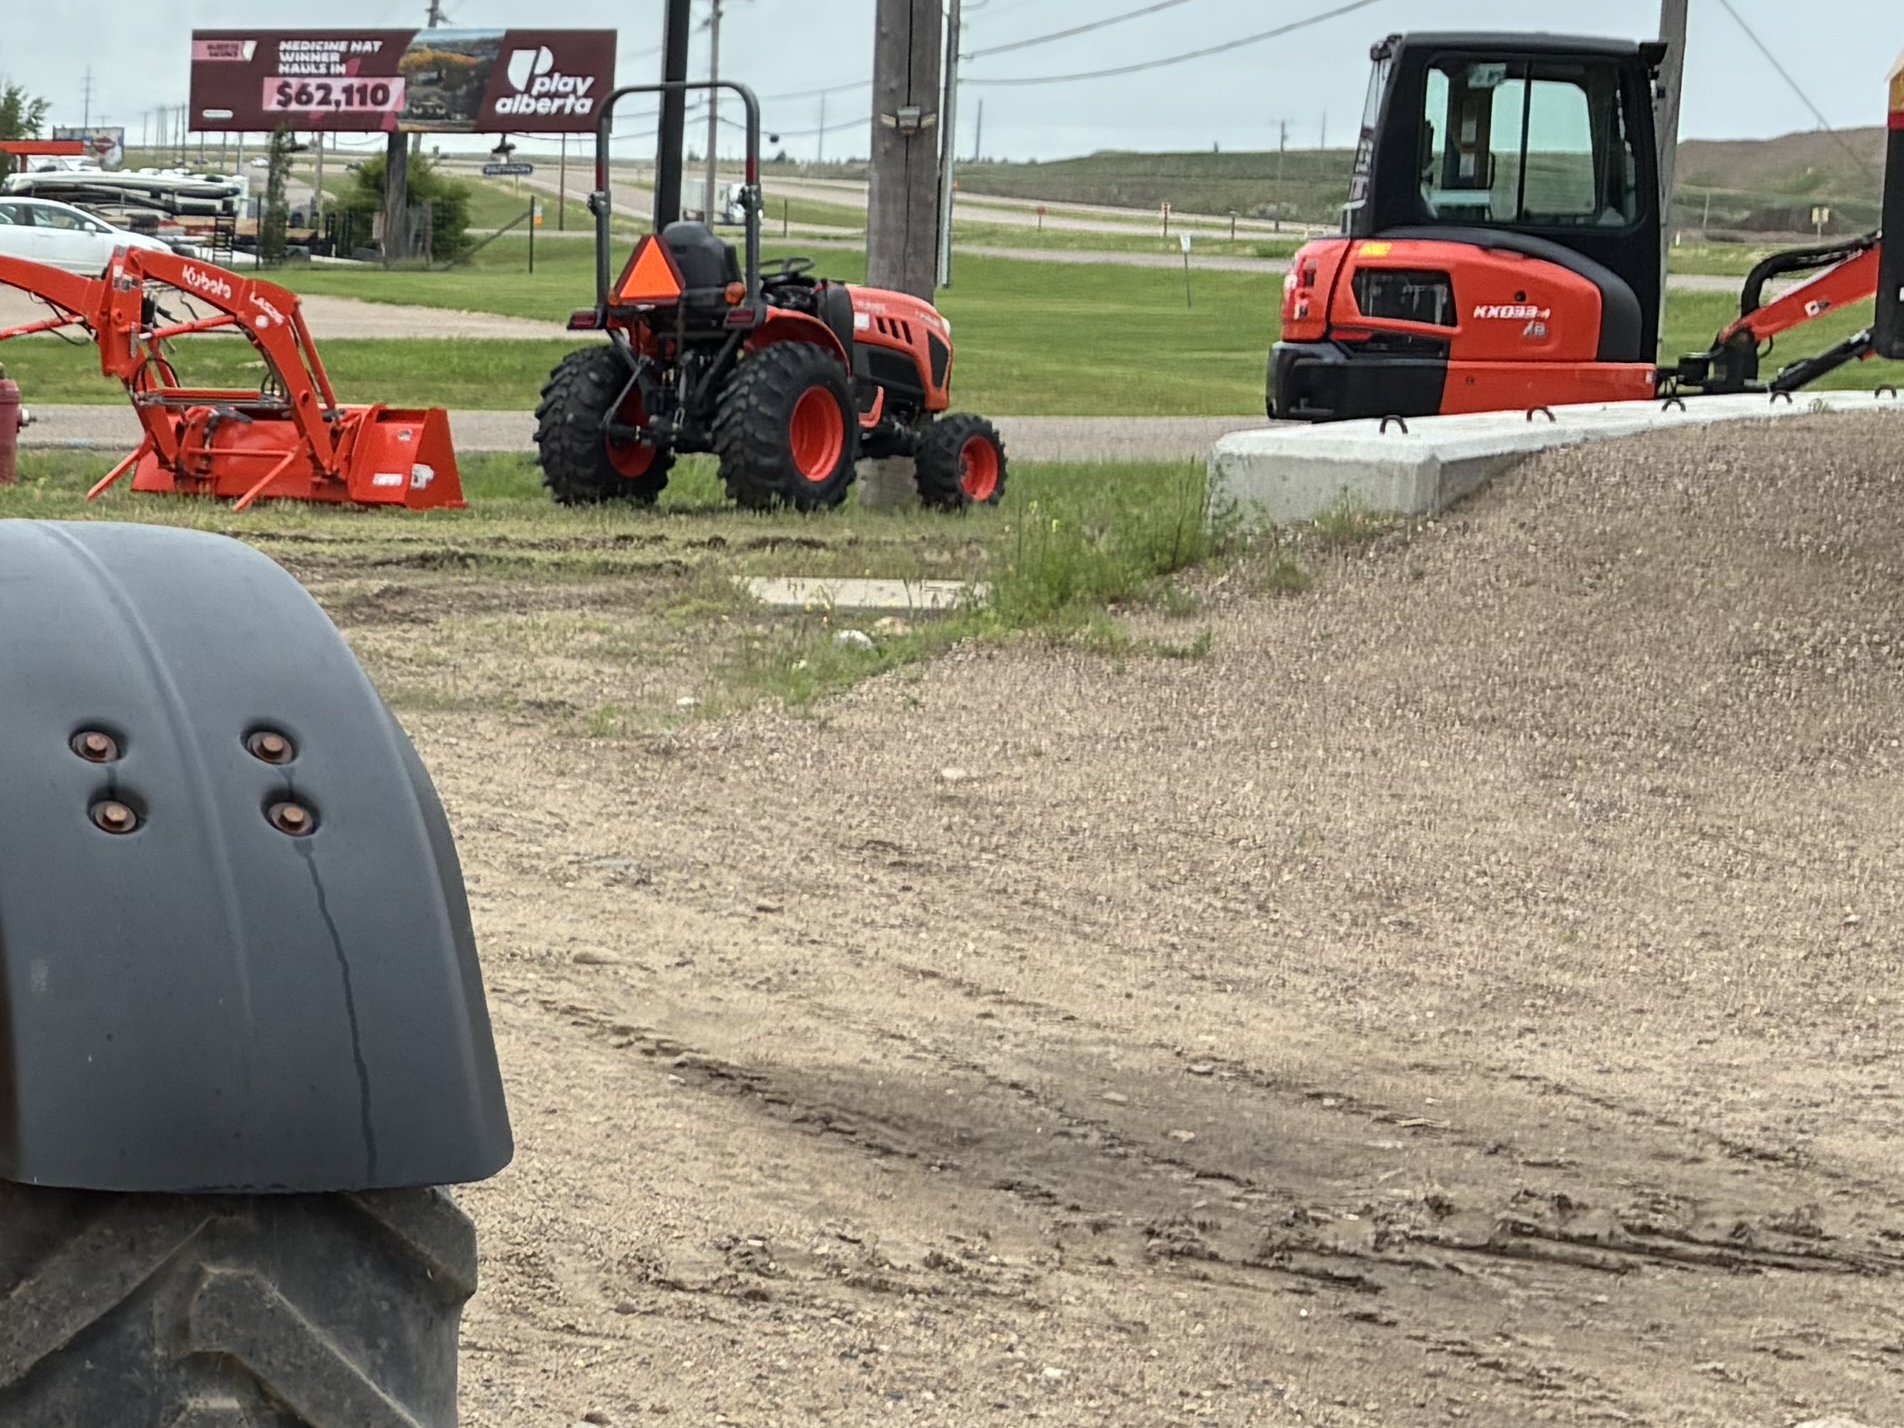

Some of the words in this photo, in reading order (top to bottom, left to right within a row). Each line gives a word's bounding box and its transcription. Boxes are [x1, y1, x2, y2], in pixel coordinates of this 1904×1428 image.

[279, 40, 348, 52] MEDICINE
[350, 40, 383, 53] HAT
[279, 52, 340, 63] WINNER
[278, 63, 328, 74] HAULS
[330, 63, 347, 75] IN
[530, 72, 594, 96] play
[276, 80, 391, 111] $62,110
[495, 93, 594, 115] alberta
[182, 264, 232, 300] Kubota
